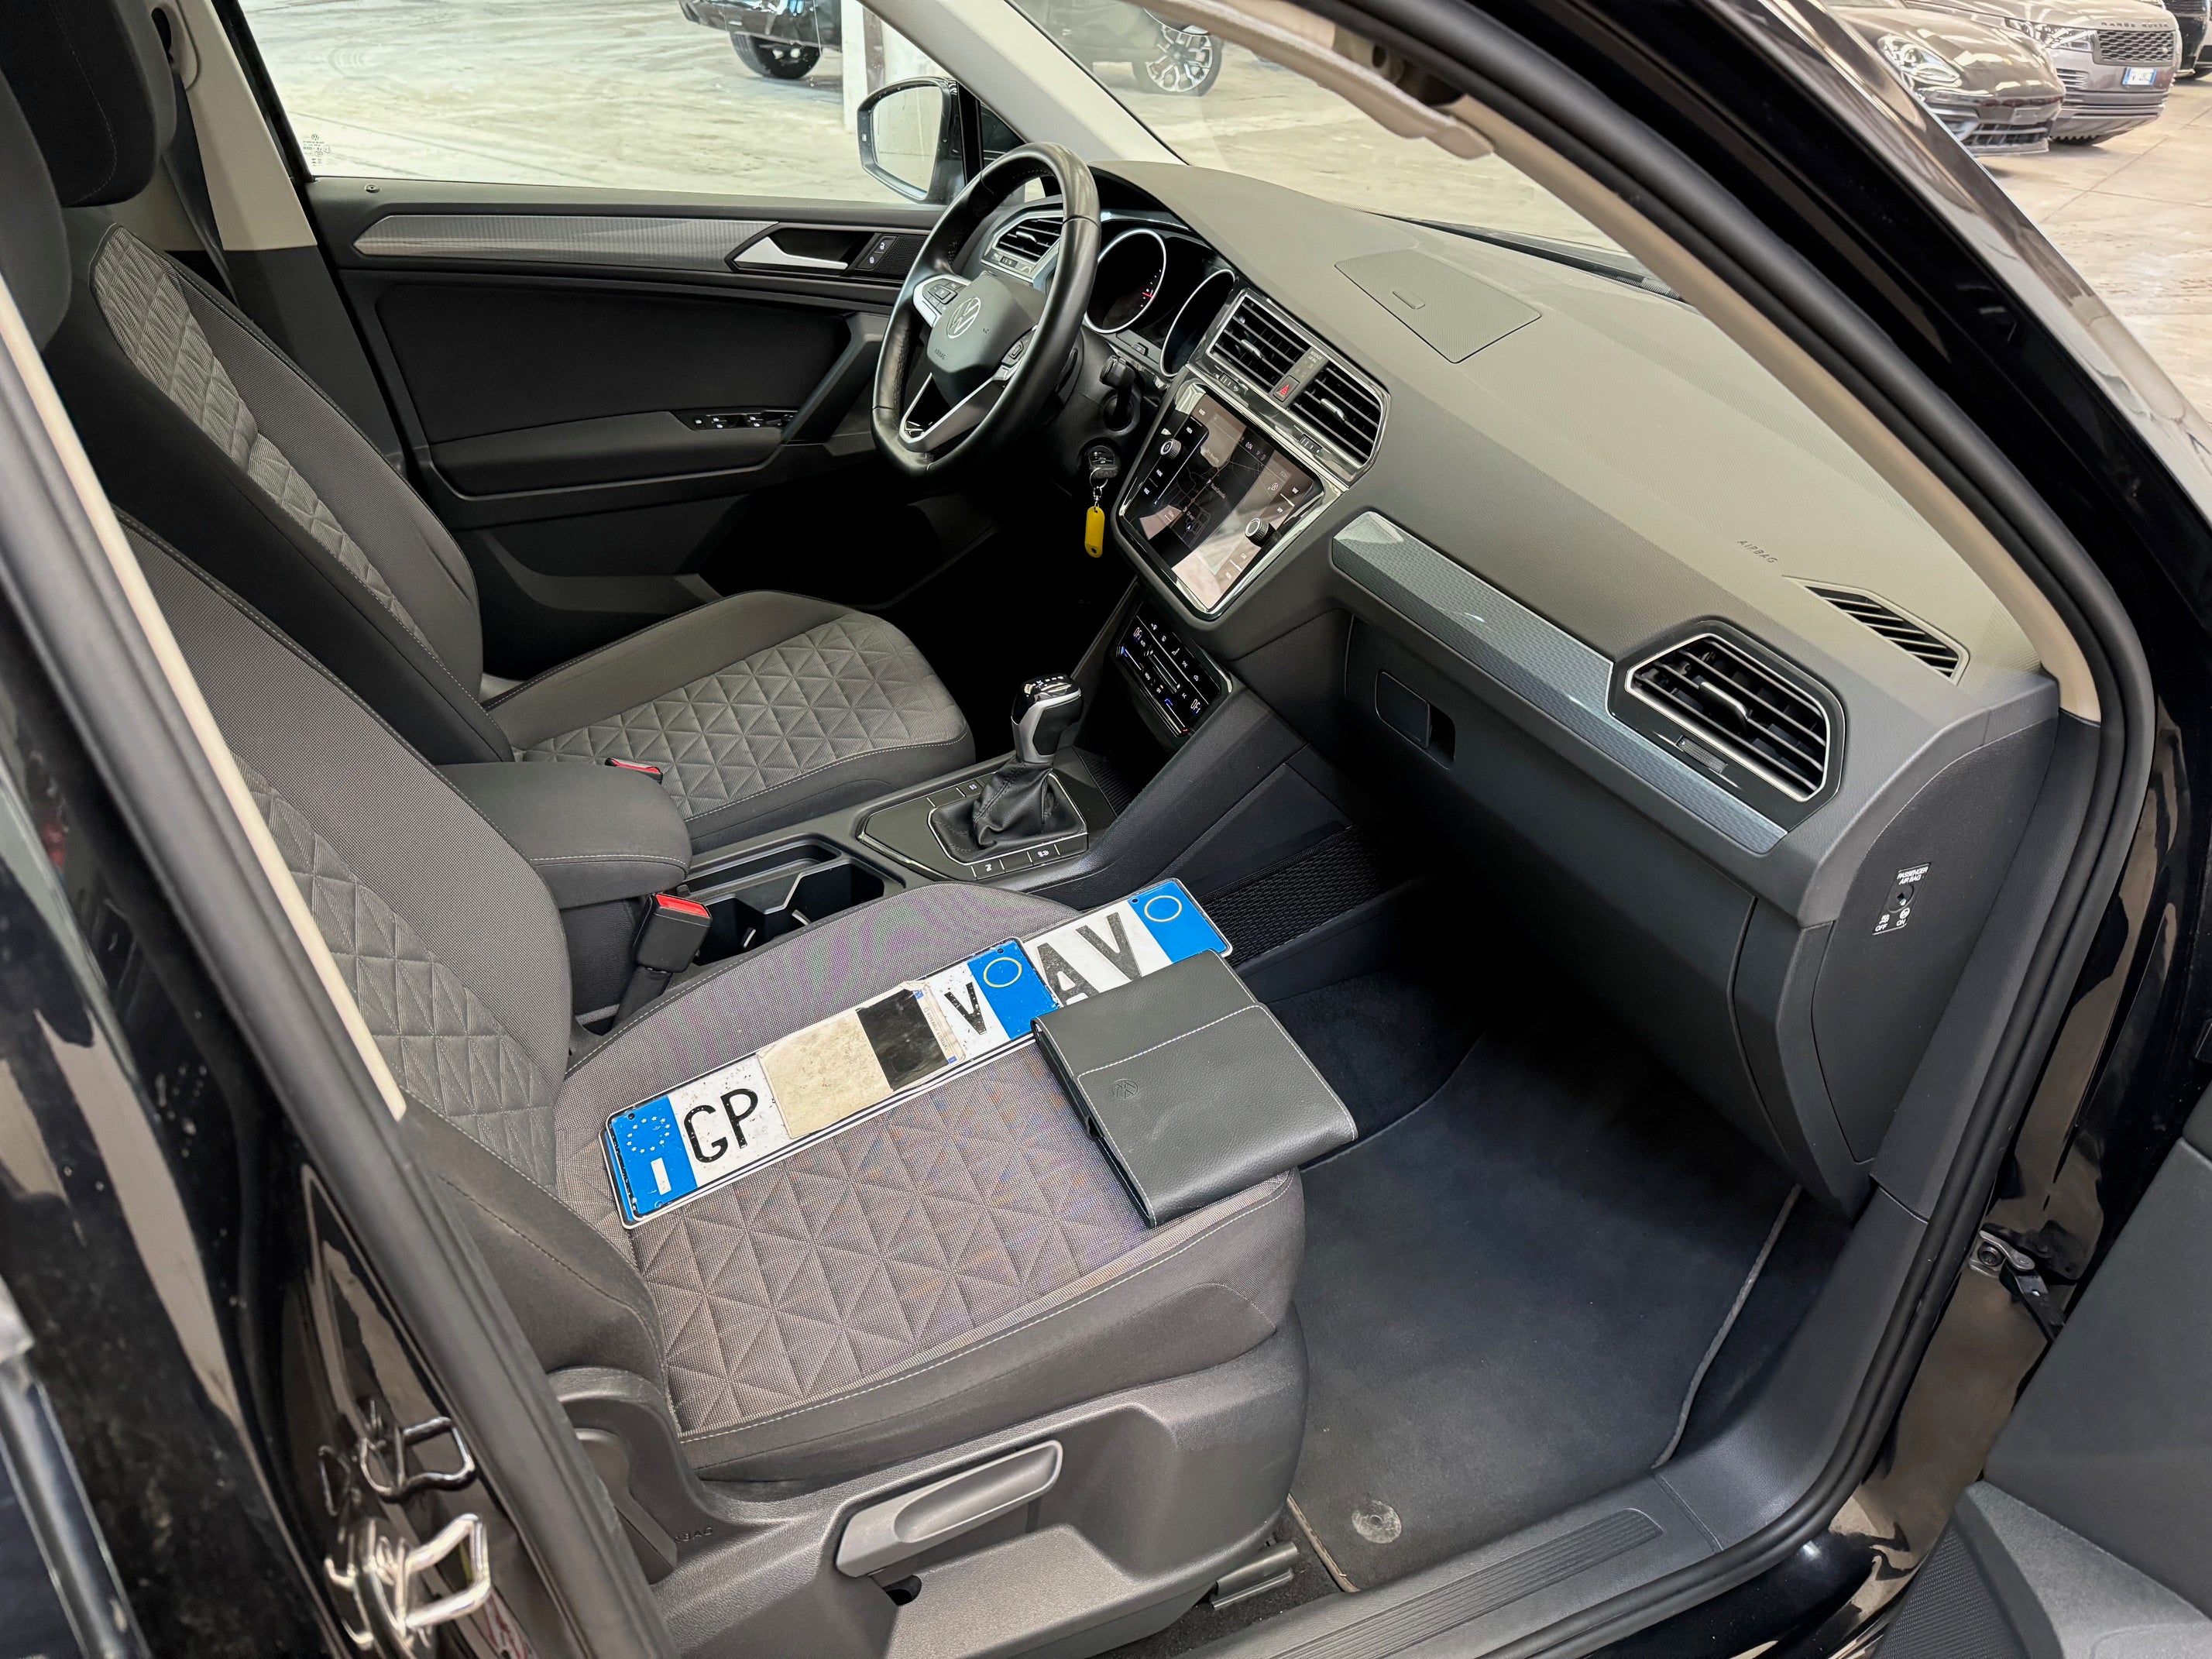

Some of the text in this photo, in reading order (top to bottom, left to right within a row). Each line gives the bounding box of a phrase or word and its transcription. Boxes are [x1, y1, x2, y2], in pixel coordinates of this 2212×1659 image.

[1737, 541, 1778, 563] AIRBAG
[1897, 866, 1929, 880] PASSENGER
[1875, 923, 1888, 932] OFF
[683, 1087, 759, 1163] GP
